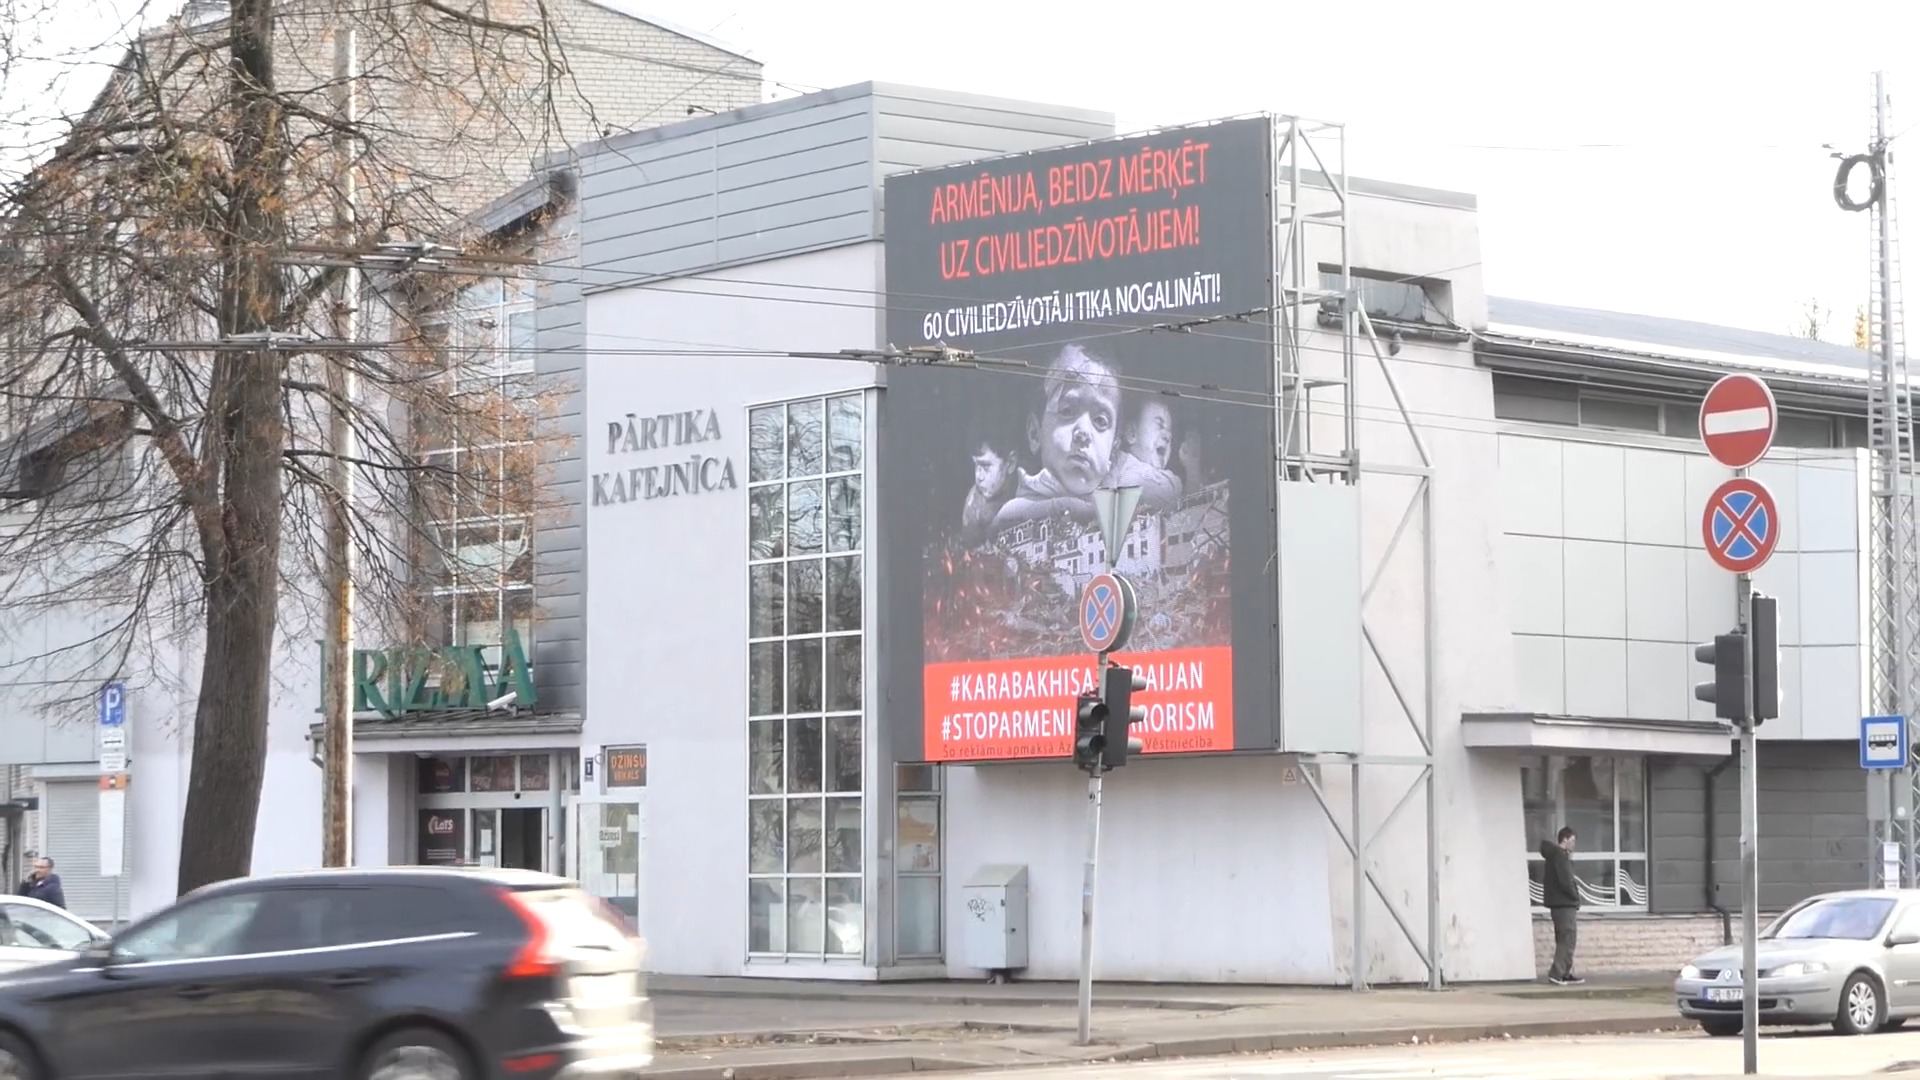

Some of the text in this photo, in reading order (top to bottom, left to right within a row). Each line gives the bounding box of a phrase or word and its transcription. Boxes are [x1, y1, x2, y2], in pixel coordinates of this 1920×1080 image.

[931, 139, 1210, 225] ARMĒNIJA, BEIDZ MĒRĶĒT
[940, 205, 1200, 281] UZ CIVILIEDZĪVOTĀJIEM!
[923, 271, 1221, 340] 60 CIVILIEDZĪVOTĀJI TIKA NOGALINĀTI!
[607, 407, 722, 455] PĀRTIKA
[592, 454, 738, 507] KAFEJNĪCA
[315, 628, 538, 721] RIZMA
[951, 660, 1203, 702] #KARABAKHISAAIJAN
[106, 688, 121, 722] P
[941, 701, 1215, 741] #STOPARMENIRORISM
